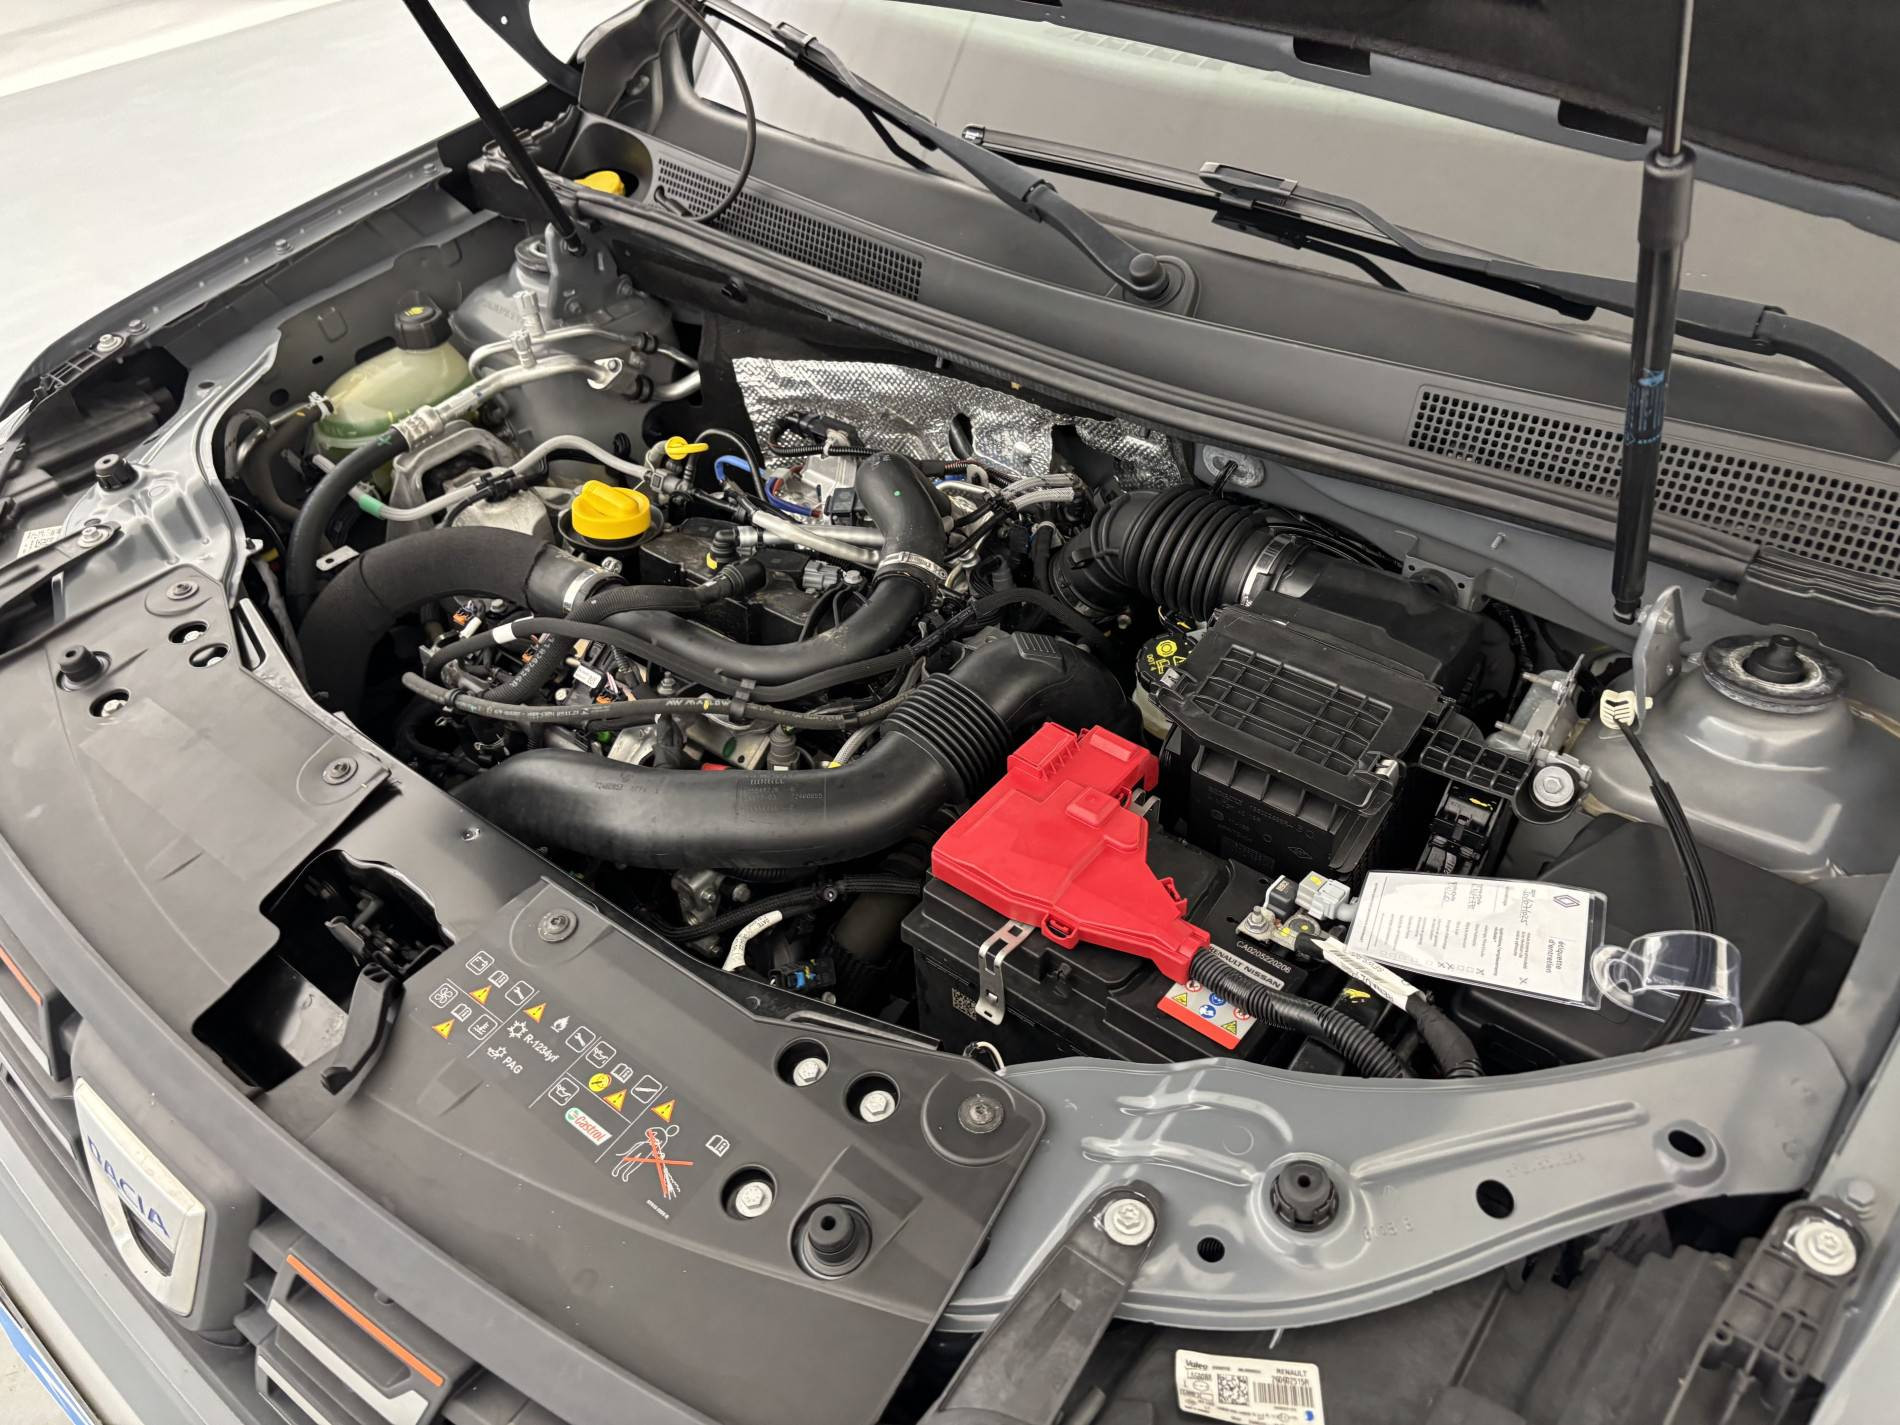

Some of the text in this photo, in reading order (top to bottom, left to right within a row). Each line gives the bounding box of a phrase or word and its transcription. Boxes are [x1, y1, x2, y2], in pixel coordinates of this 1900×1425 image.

[1147, 654, 1156, 665] DOT
[1208, 944, 1281, 989] RENAULT NISSAN
[1544, 939, 1555, 974] d'entretien
[1554, 941, 1566, 970] étiquette
[523, 1033, 560, 1063] R-1234yf
[502, 1056, 524, 1075] PAG
[574, 1115, 607, 1142] Castrol
[88, 1135, 170, 1238] DACIA
[1276, 1368, 1307, 1377] RENAULT
